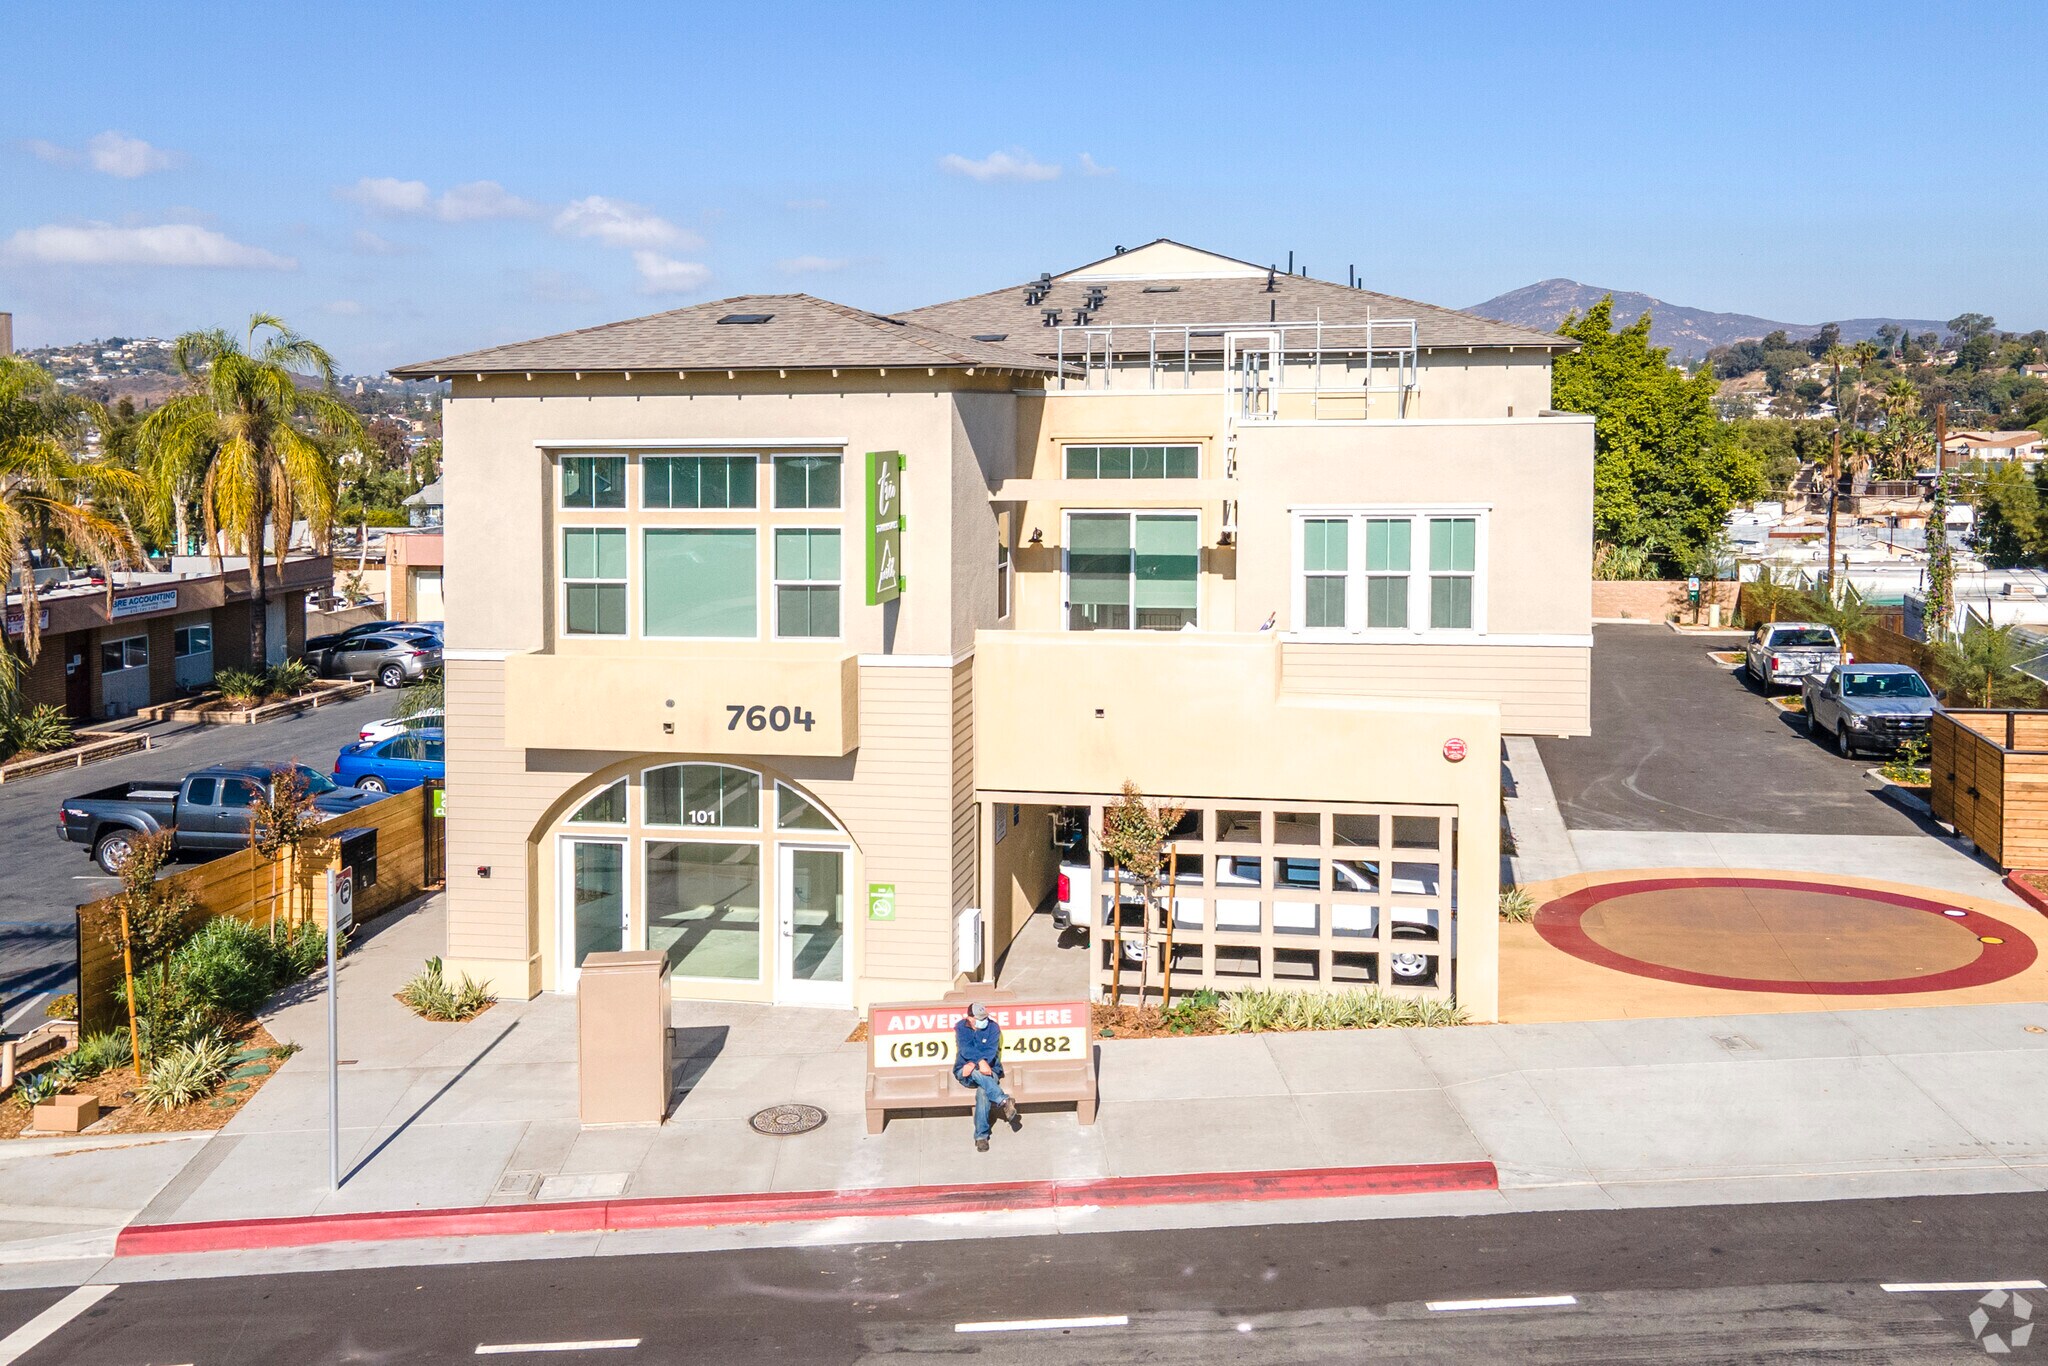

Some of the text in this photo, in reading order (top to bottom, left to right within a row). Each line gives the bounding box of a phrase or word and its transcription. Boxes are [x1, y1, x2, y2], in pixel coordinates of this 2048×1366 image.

[128, 592, 176, 605] ACCOUNTING
[726, 705, 816, 732] 7604
[688, 810, 716, 824] 101
[888, 1009, 1072, 1031] ADVERE HERE
[890, 1036, 1071, 1062] (619) -4082
